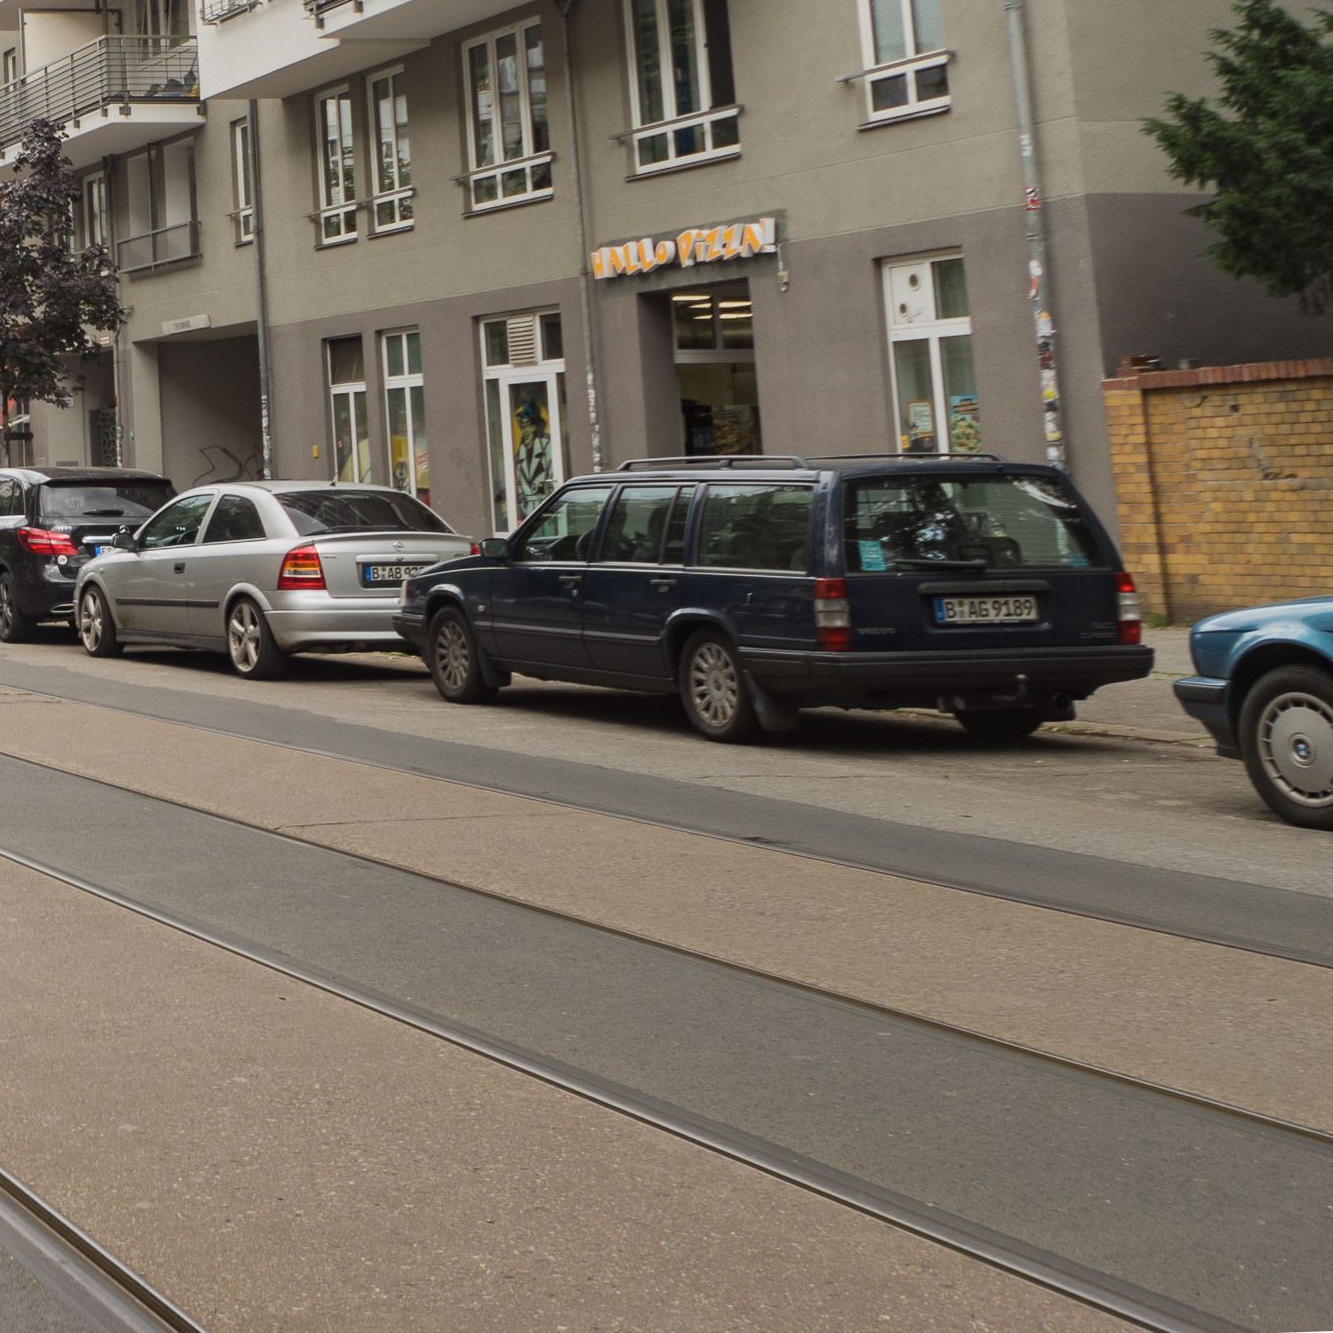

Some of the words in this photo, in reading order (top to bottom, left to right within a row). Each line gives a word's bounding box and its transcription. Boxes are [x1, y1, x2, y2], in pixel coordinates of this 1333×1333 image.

[591, 238, 676, 279] HALLO
[372, 567, 380, 579] B
[388, 567, 402, 579] AB
[945, 601, 956, 619] B
[968, 600, 989, 619] AG
[992, 599, 1033, 618] 9189
